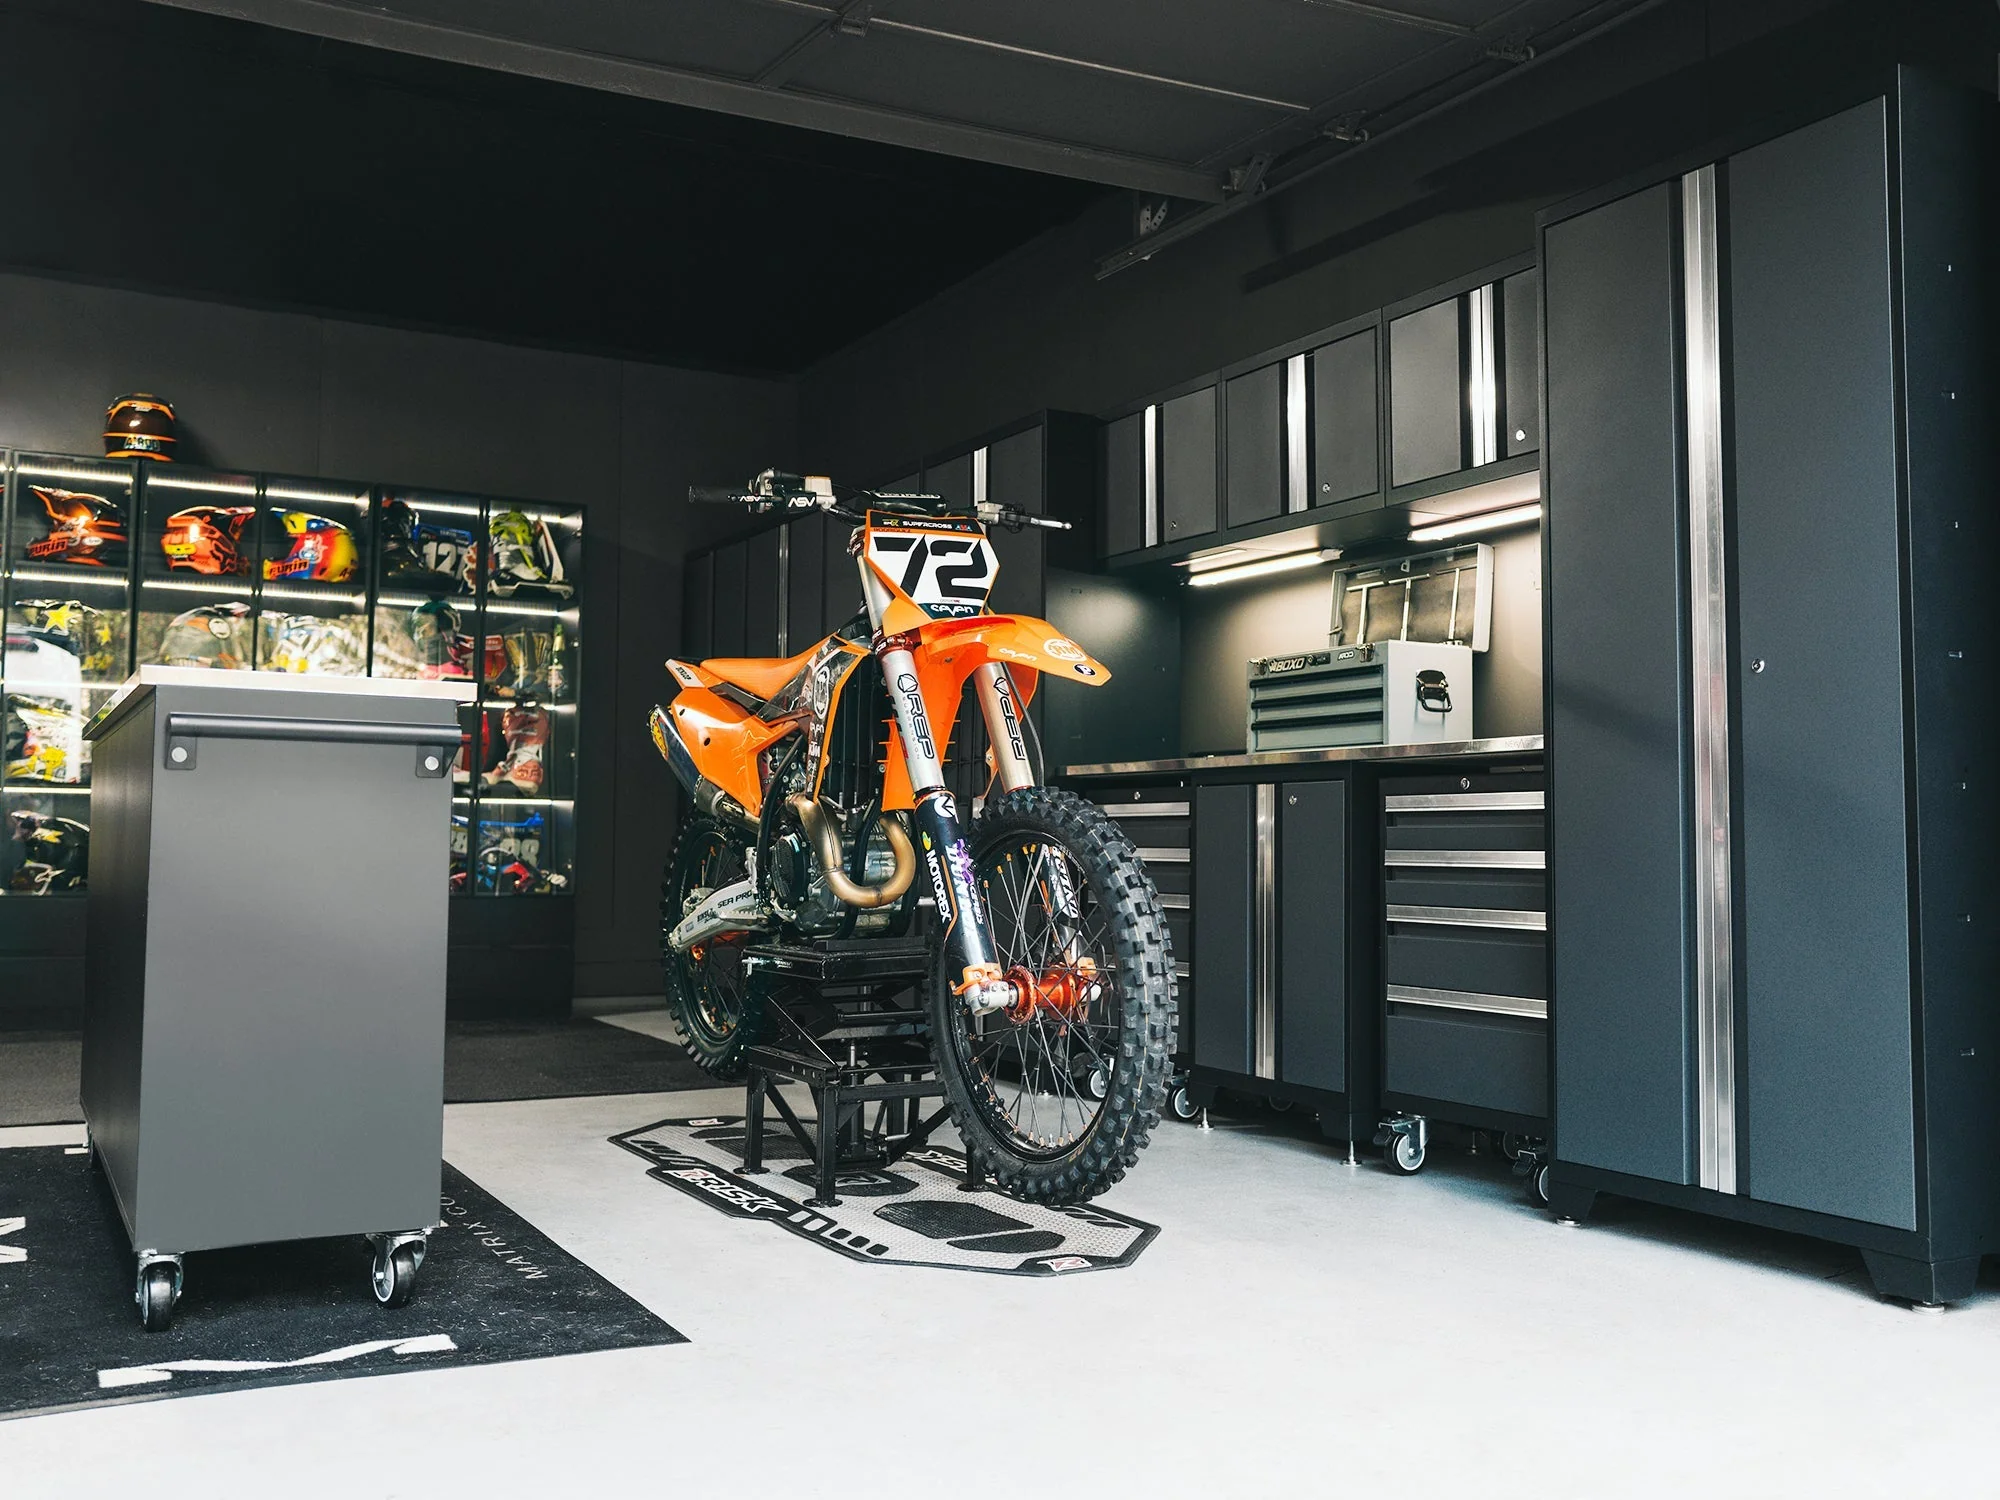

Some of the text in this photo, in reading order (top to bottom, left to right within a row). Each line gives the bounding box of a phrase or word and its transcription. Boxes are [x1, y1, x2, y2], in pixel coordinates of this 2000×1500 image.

[788, 496, 816, 508] ASV
[873, 533, 990, 601] 72
[1276, 657, 1305, 672] BOXO
[907, 693, 935, 759] REP
[999, 696, 1026, 761] REP
[925, 849, 952, 924] MOTOREX
[463, 1221, 549, 1280] MATRIX
